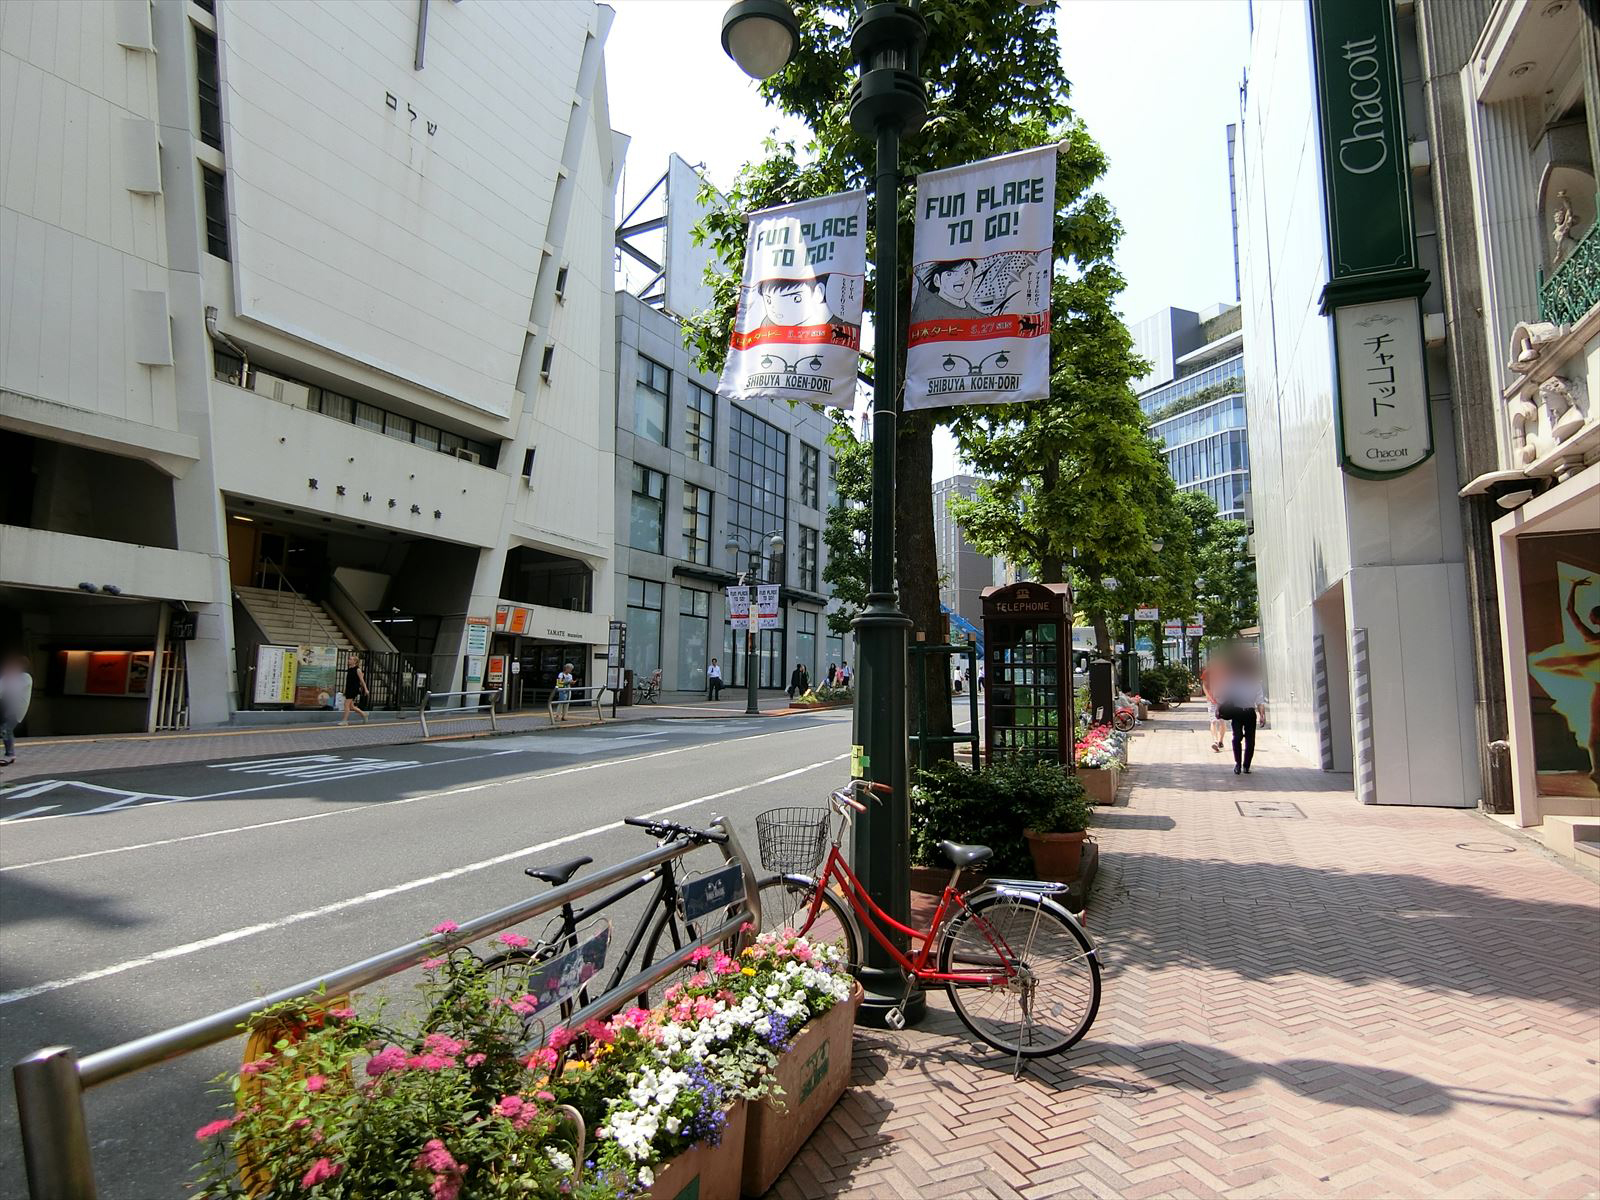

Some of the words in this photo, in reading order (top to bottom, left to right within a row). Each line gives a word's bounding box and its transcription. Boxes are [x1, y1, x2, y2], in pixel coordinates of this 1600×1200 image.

[1339, 35, 1388, 175] Chacott
[925, 192, 965, 220] FUN
[976, 177, 1044, 213] PLACE
[756, 226, 790, 252] FUN
[799, 215, 858, 243] PLACE
[947, 219, 973, 246] TO
[984, 211, 1019, 242] GO!
[772, 248, 796, 267] TO
[804, 241, 835, 267] GO!
[746, 374, 780, 388] SHIBUYA
[785, 375, 832, 392] KOEN-DORI
[927, 378, 965, 394] SHIBUYA
[970, 376, 1020, 390] KOEN-DORI
[1363, 333, 1396, 417] チャコット
[1366, 447, 1409, 459] Chacott
[996, 601, 1050, 613] TELEPHONE
[547, 629, 566, 637] YAMATE
